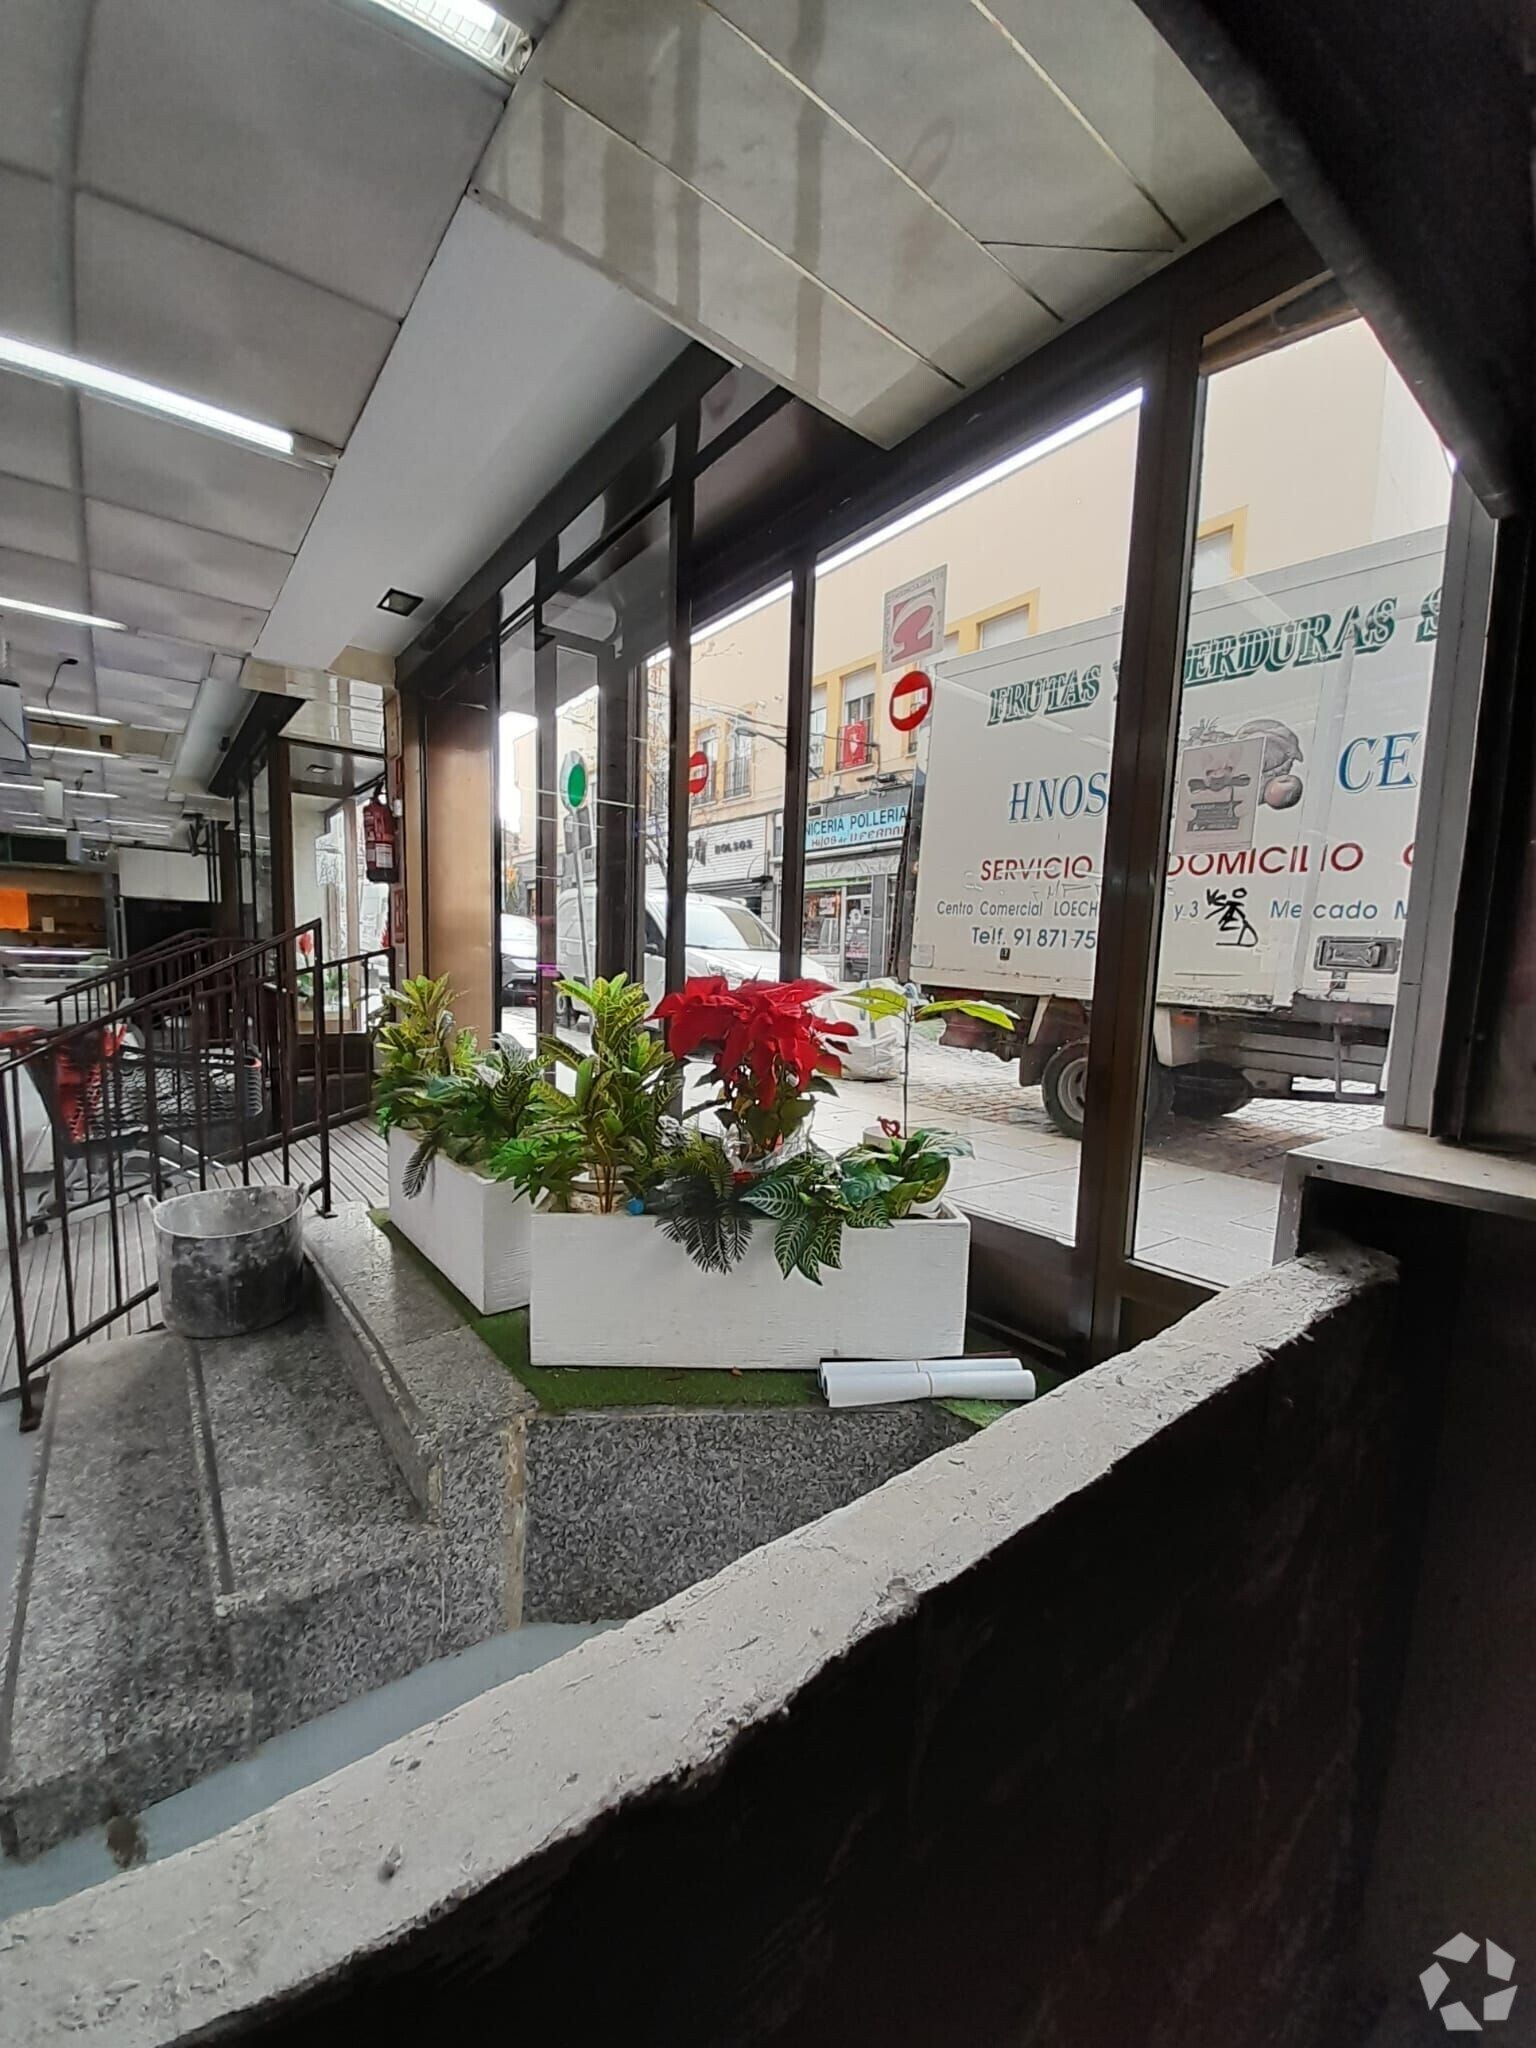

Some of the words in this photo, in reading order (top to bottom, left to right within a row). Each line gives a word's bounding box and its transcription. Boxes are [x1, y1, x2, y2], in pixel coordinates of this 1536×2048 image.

[986, 664, 1102, 727] FRUTAS
[1008, 772, 1108, 823] HNOS
[1337, 730, 1421, 794] CE
[850, 806, 907, 830] POLLERIA
[714, 839, 753, 854] BOLSOS
[980, 855, 1093, 881] SERVICIO
[936, 900, 973, 916] Centro
[979, 901, 1043, 917] Comercial
[1270, 900, 1377, 920] Mecado
[972, 927, 1006, 945] Telf.
